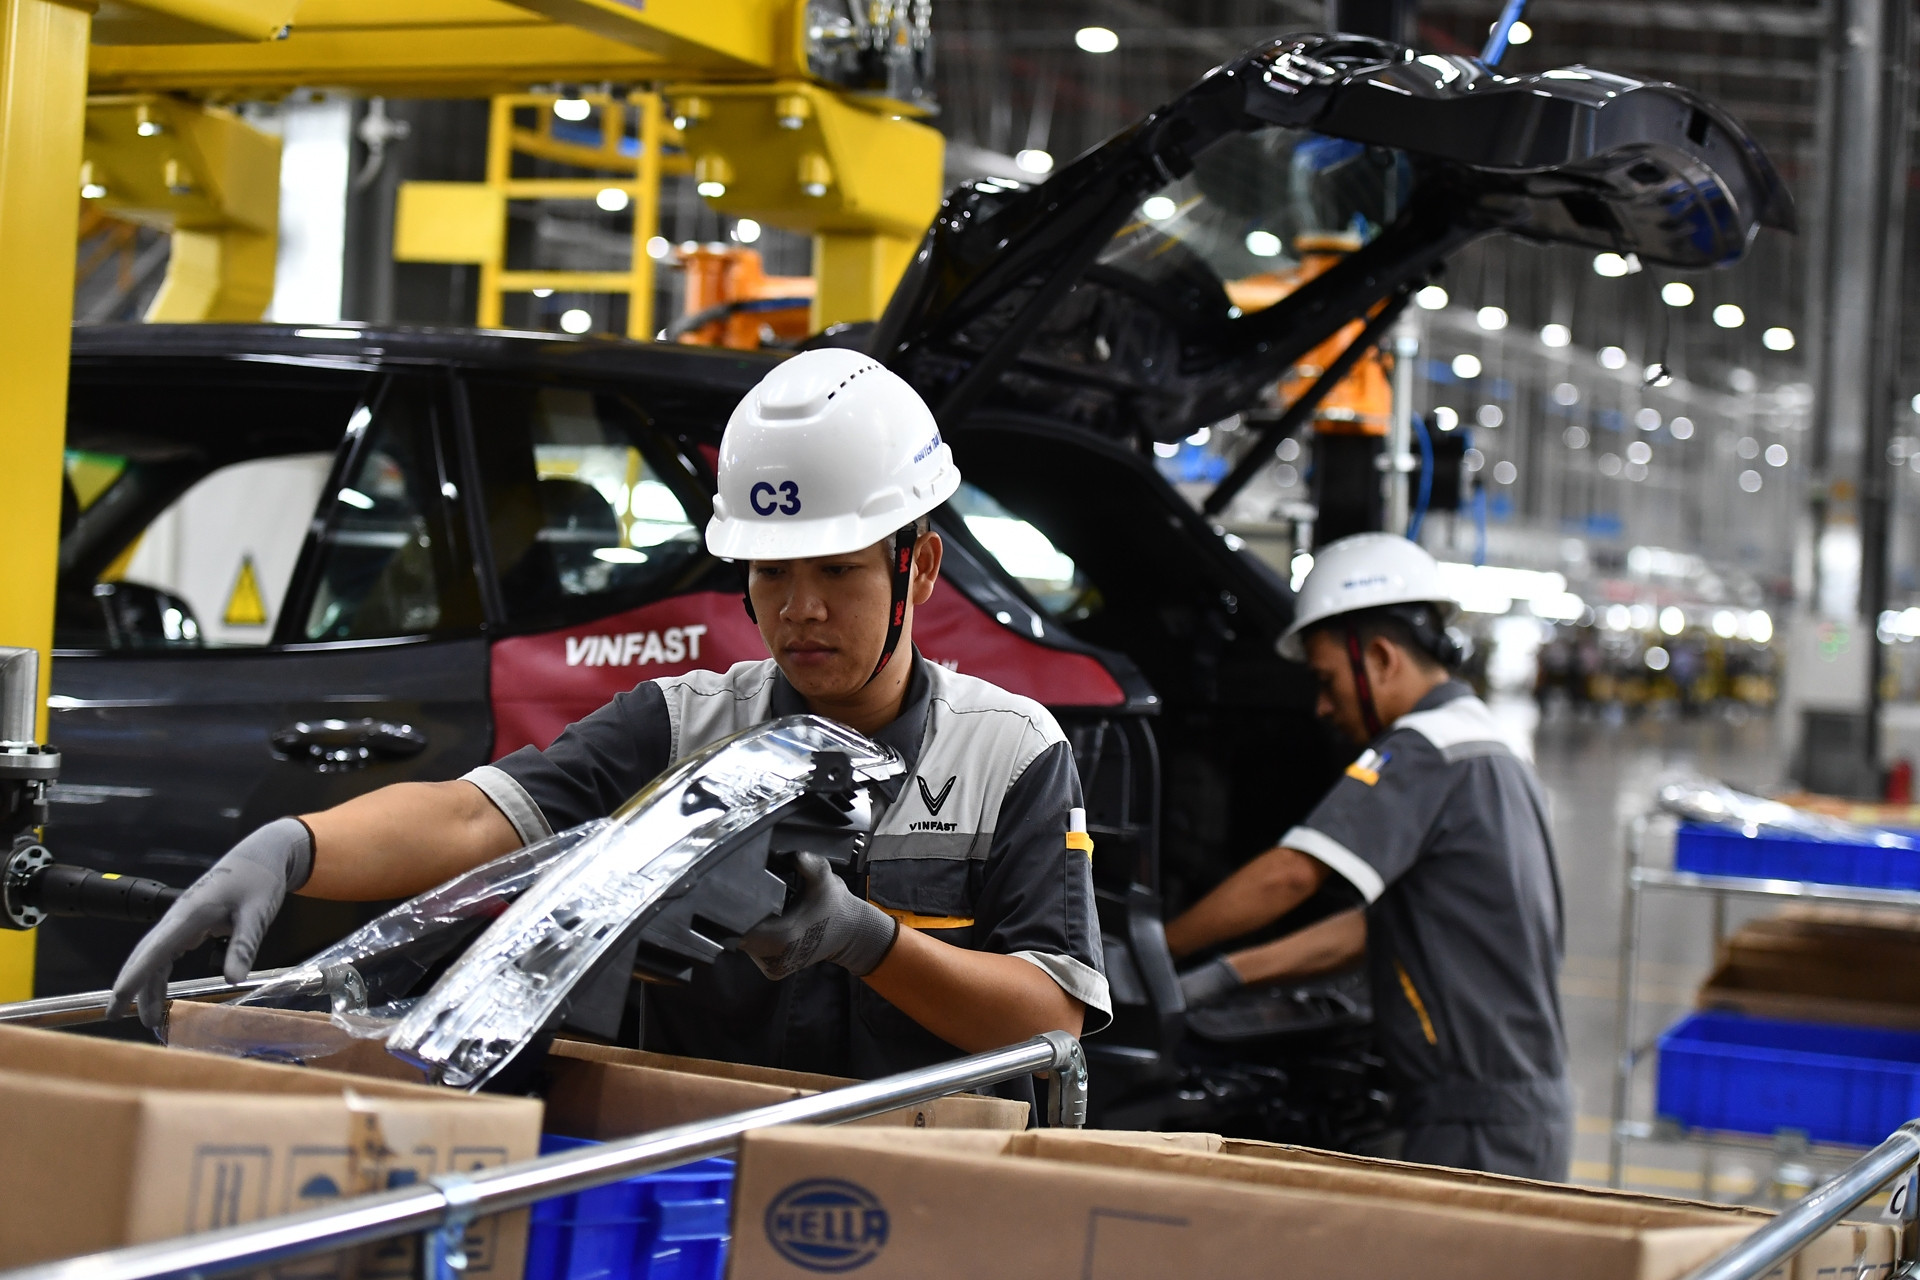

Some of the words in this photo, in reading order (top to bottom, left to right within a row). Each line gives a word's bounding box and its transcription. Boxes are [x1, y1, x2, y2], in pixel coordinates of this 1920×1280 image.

[750, 480, 801, 516] C3
[900, 547, 911, 572] 3M
[894, 600, 905, 626] 3M
[565, 624, 708, 667] VINFAST
[909, 821, 957, 832] VINFAST
[776, 1209, 888, 1247] HELLA
